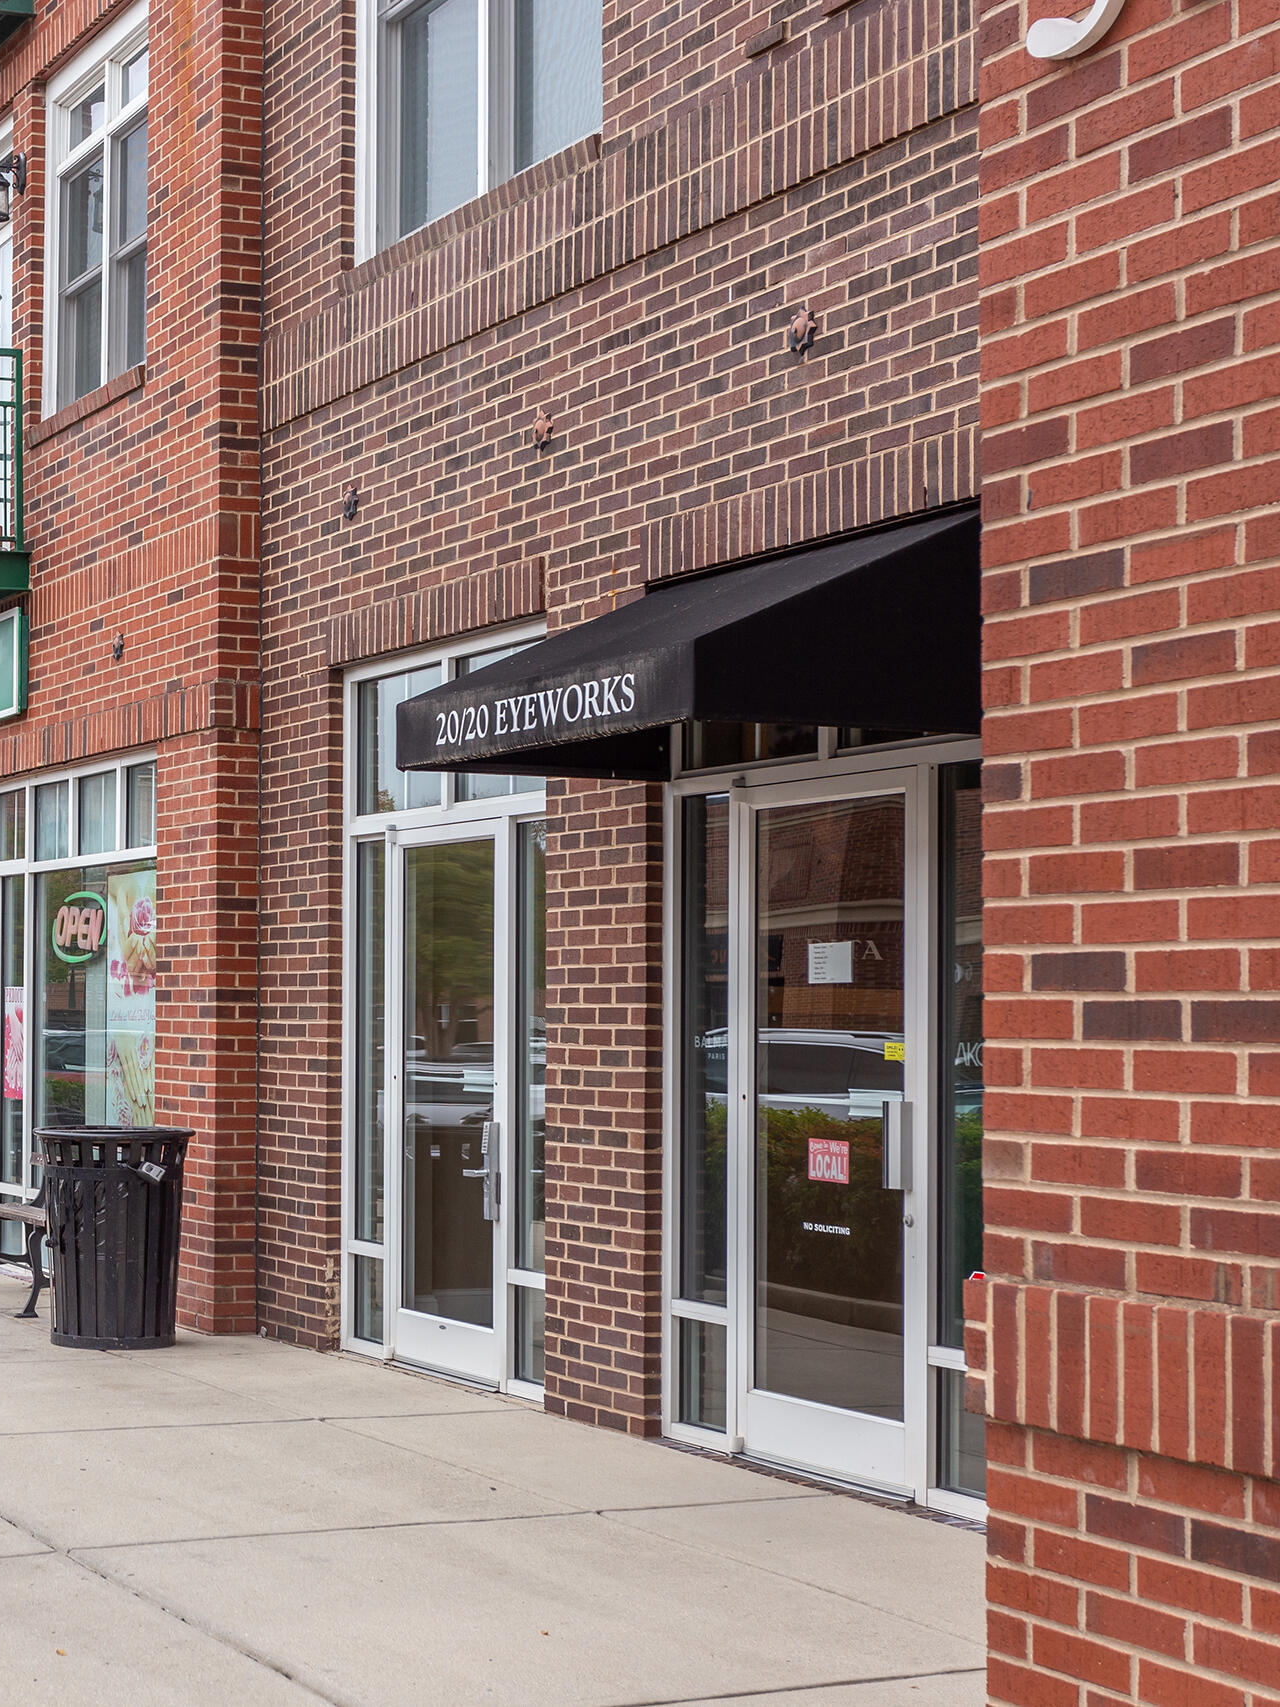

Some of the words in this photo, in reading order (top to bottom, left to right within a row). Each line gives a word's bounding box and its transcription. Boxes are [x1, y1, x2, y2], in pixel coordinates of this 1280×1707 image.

[435, 704, 489, 746] 20/20
[494, 673, 636, 736] EYEWORKS
[55, 905, 103, 951] OPEN
[829, 1141, 849, 1155] We're
[810, 1153, 847, 1180] LOCAL!
[803, 1221, 813, 1231] NO
[814, 1223, 851, 1236] SOLICITING
